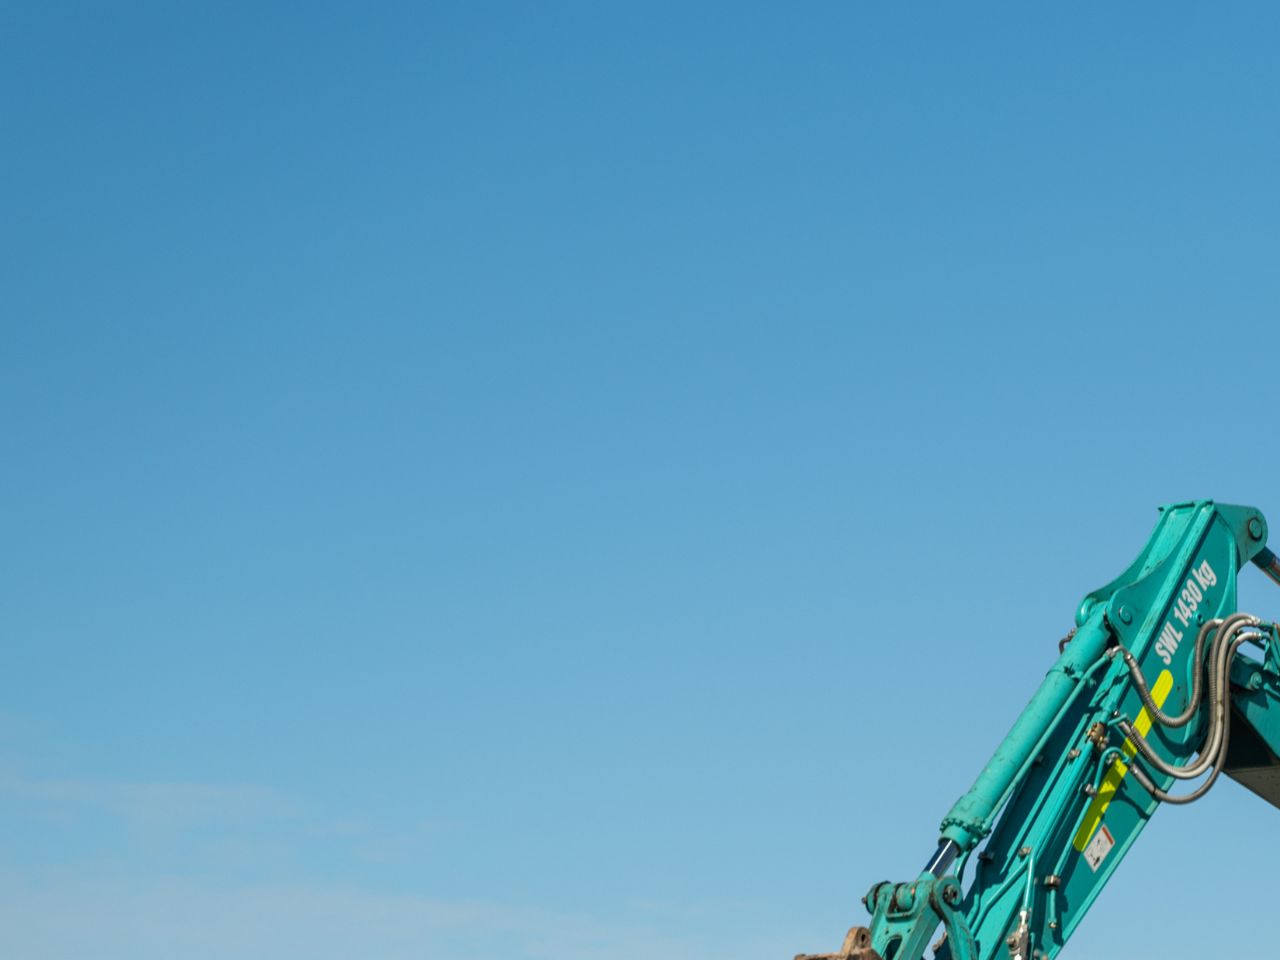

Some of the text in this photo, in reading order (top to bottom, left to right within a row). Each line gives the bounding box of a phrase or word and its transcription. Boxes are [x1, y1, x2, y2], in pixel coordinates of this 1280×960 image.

[1155, 559, 1217, 666] SWL 1430 kg
